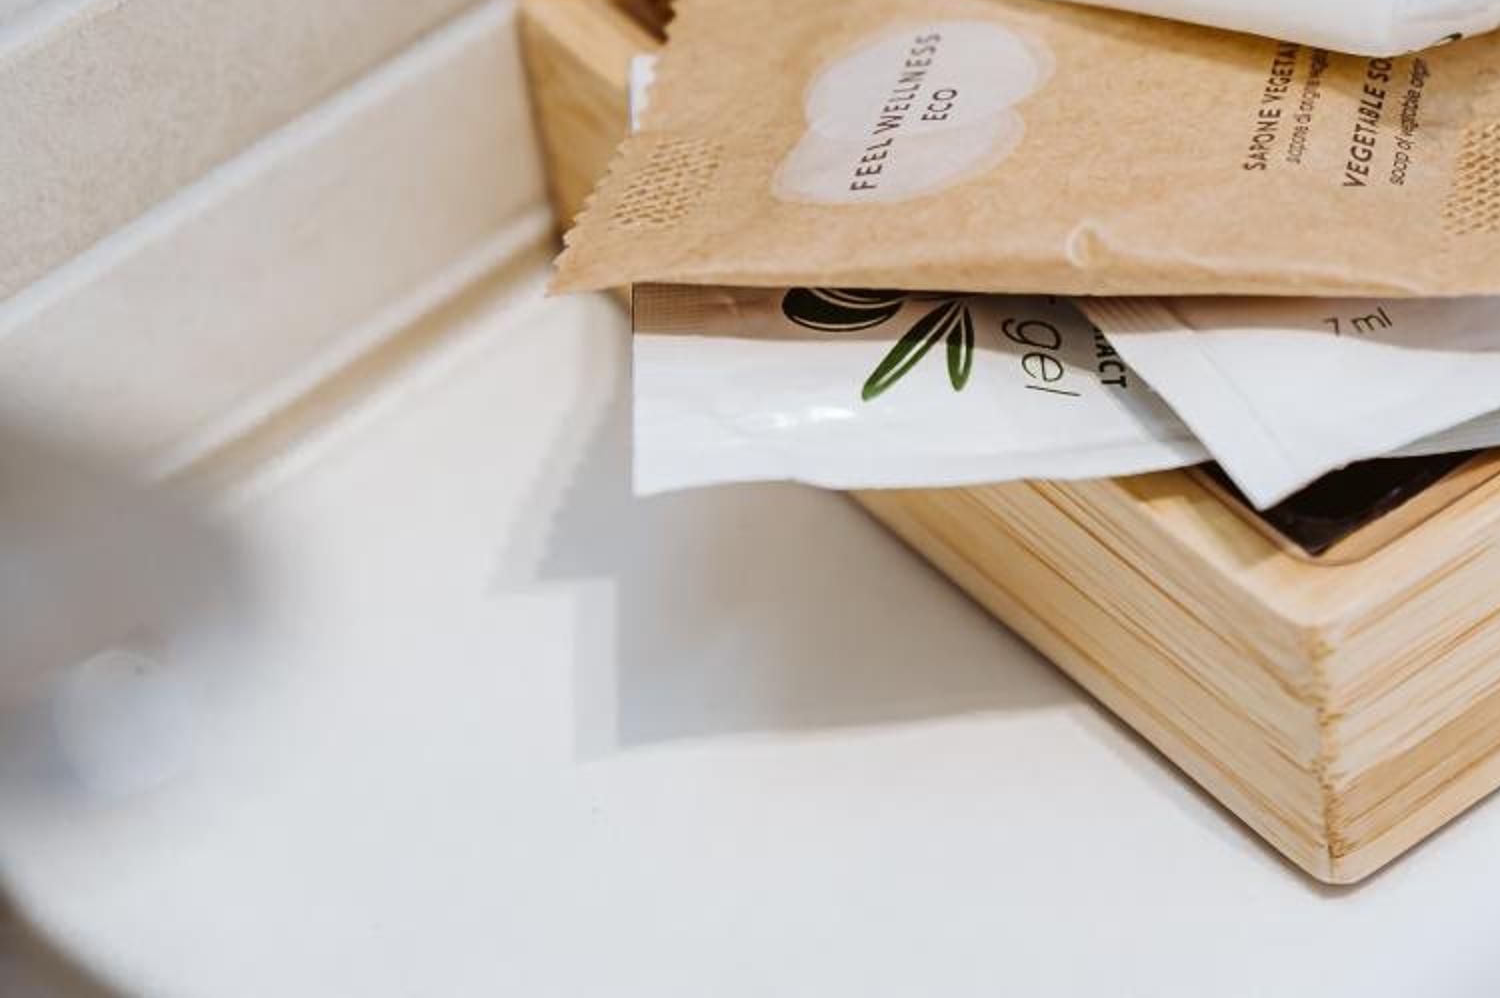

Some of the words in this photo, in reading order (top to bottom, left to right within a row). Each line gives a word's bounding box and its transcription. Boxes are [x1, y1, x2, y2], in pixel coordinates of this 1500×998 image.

[848, 136, 895, 192] FEEL
[872, 32, 943, 136] WELLNESS
[920, 87, 959, 122] ECO
[1242, 108, 1282, 172] SAPONE
[1342, 83, 1387, 188] VEGETABLE
[1366, 55, 1394, 84] SO
[1001, 317, 1081, 398] gel
[1322, 316, 1340, 337] 7
[1350, 306, 1393, 334] ml
